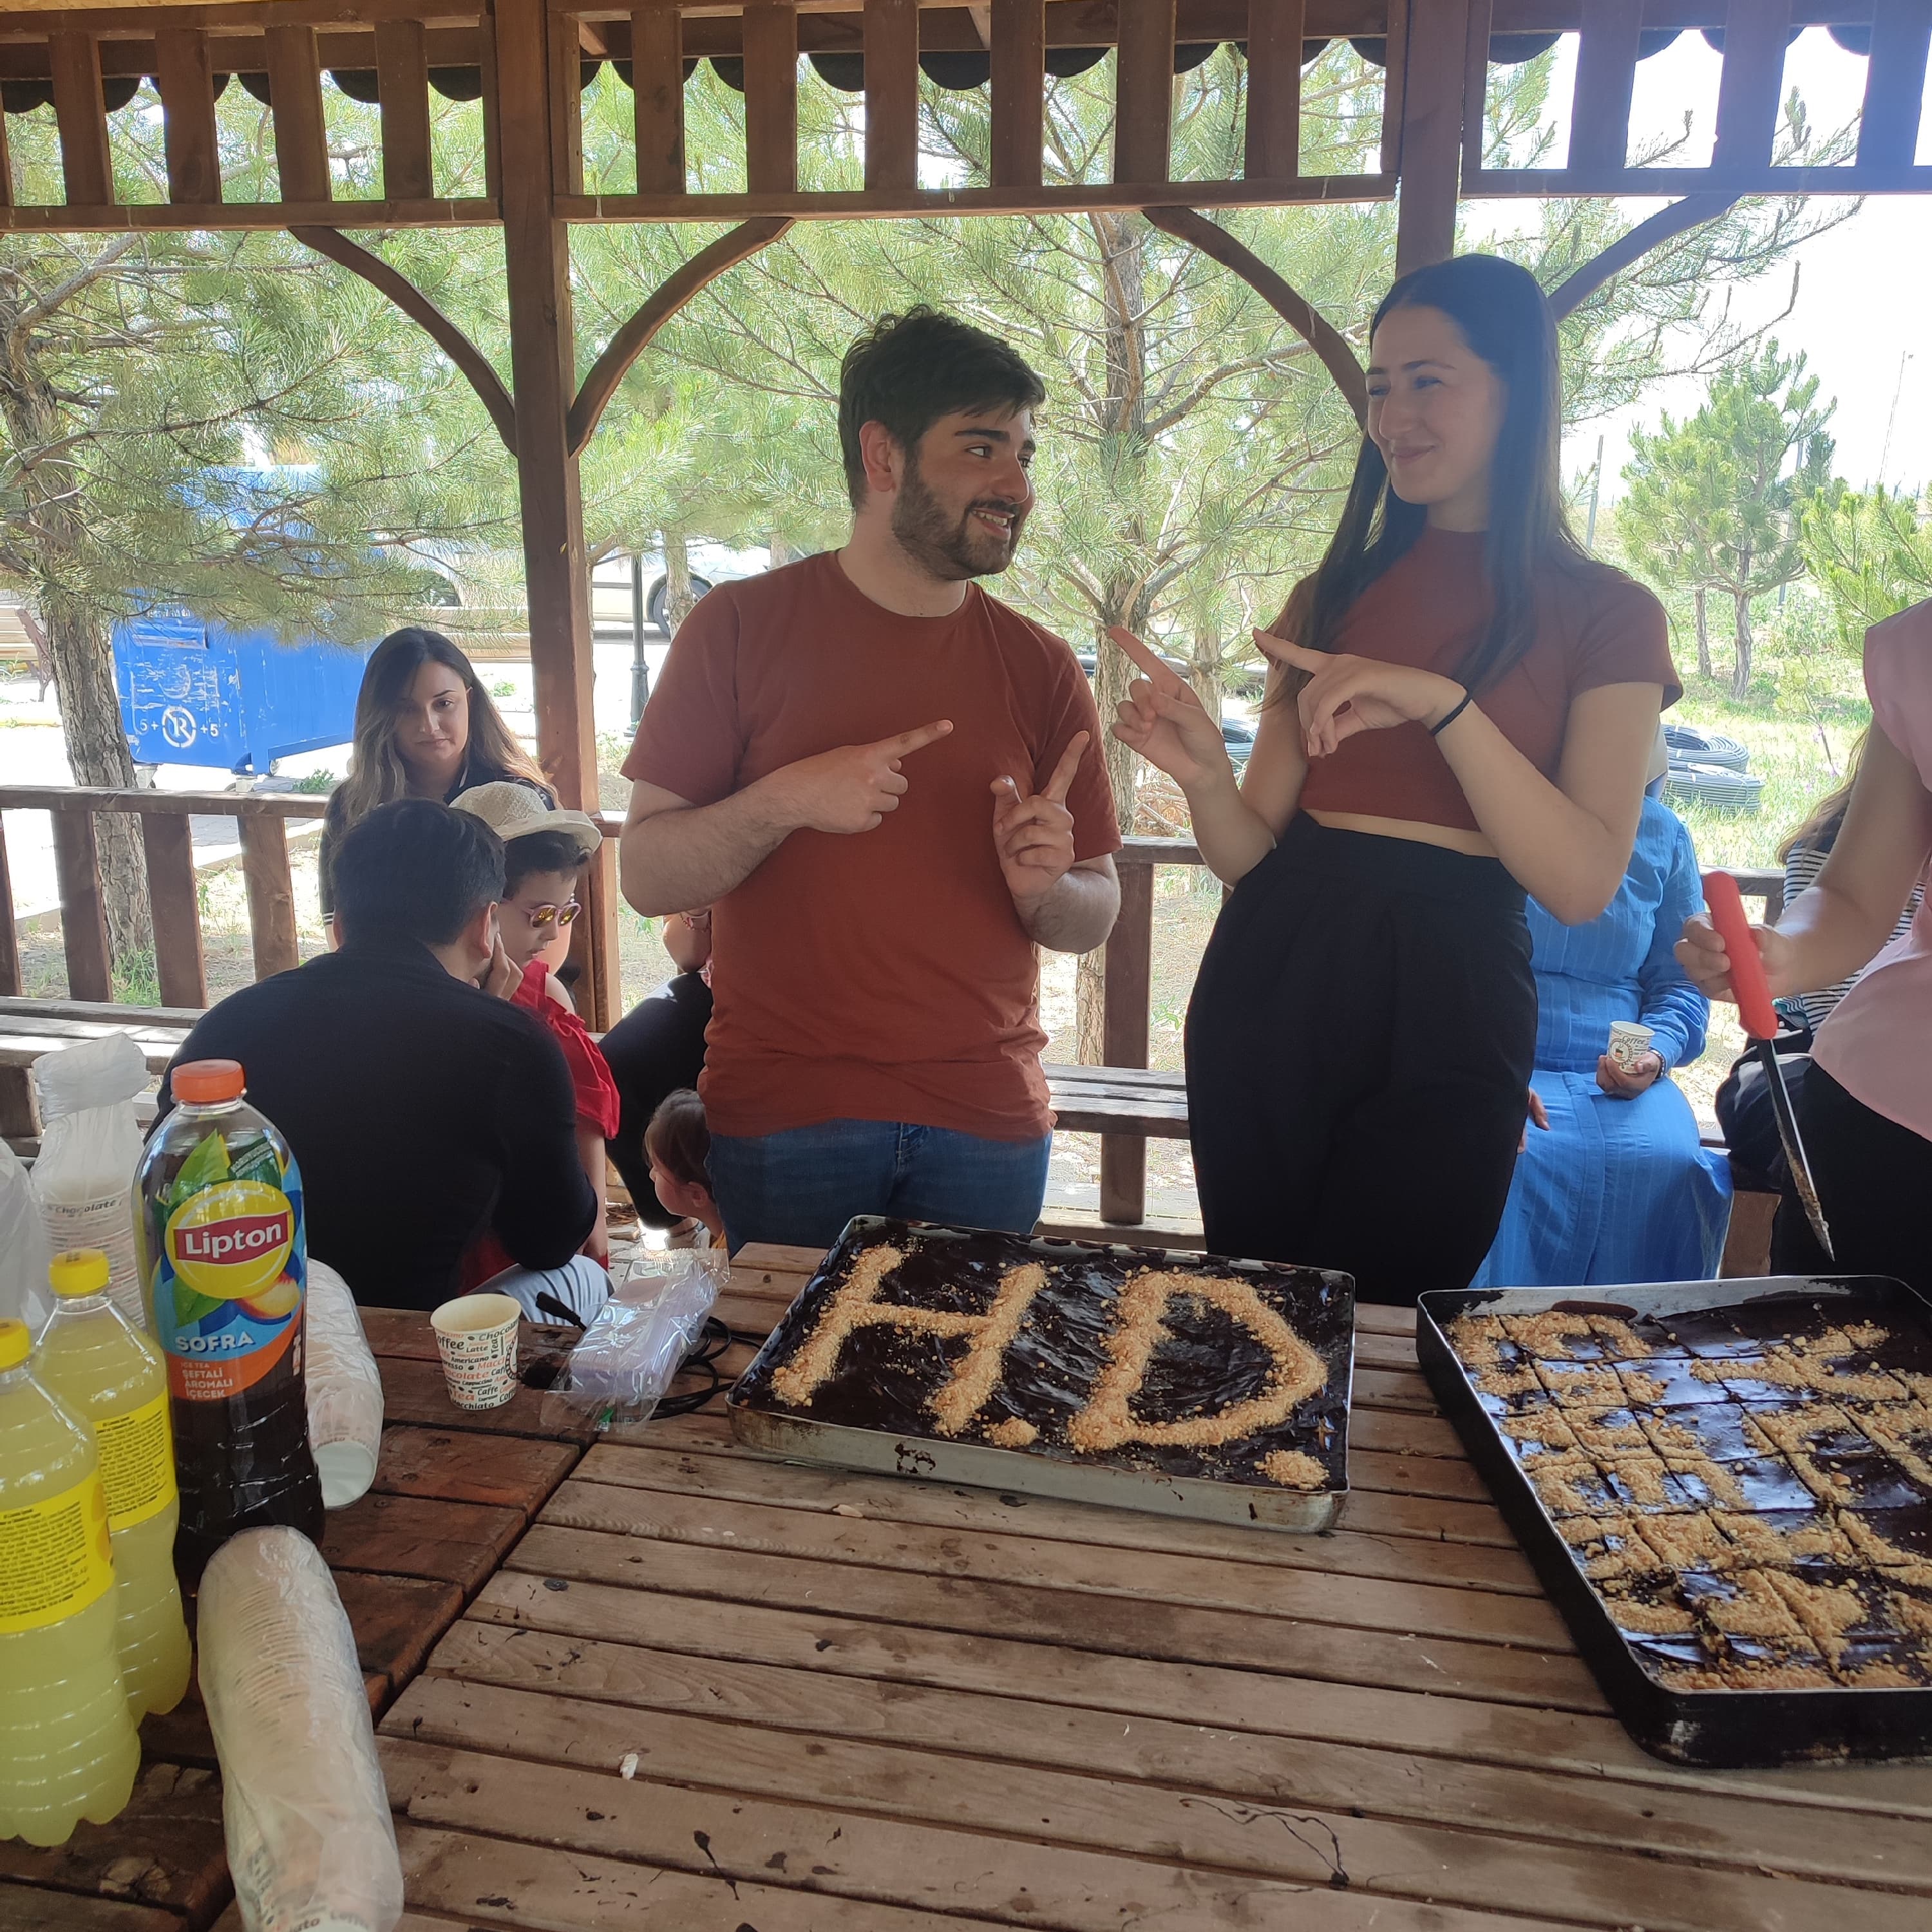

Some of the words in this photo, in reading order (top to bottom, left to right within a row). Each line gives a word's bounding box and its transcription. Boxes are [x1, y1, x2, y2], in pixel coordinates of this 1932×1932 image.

[1623, 1036, 1646, 1045] Coffee
[185, 1223, 281, 1258] Lipton
[175, 1331, 256, 1352] SOFRA
[437, 1336, 465, 1350] offee
[451, 1355, 489, 1364] Americano
[182, 1367, 223, 1379] ŞEFTALİ
[185, 1378, 234, 1388] AROMALI
[462, 1377, 493, 1386] Cappuccino
[453, 1390, 475, 1401] Tea
[477, 1386, 498, 1396] Caffe
